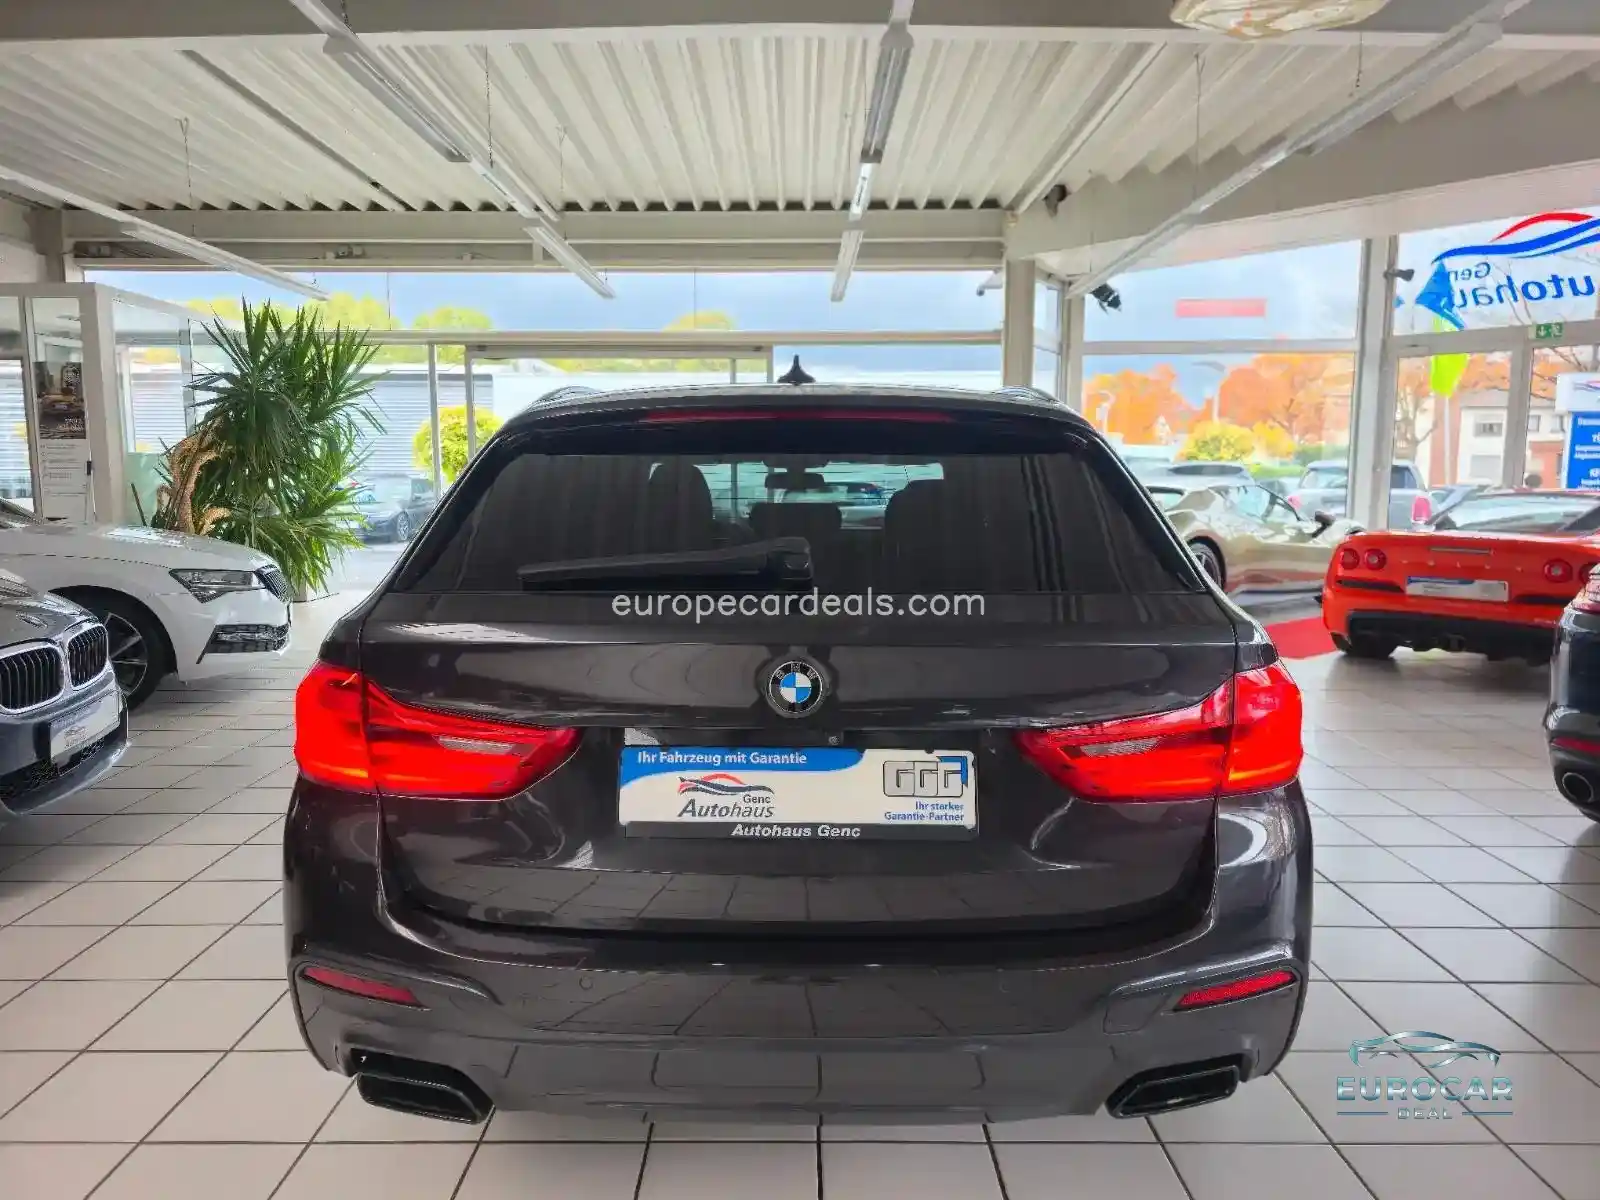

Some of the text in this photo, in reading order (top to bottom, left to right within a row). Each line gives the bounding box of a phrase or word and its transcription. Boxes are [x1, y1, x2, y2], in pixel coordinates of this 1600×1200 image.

[638, 751, 807, 767] Ihr Fahrzeug mit Garantie
[743, 794, 771, 804] Genc
[677, 798, 775, 818] Autohaus
[915, 801, 929, 811] Ihr
[884, 811, 964, 821] Garantie-Partner
[731, 823, 861, 837] Autohaus Genc
